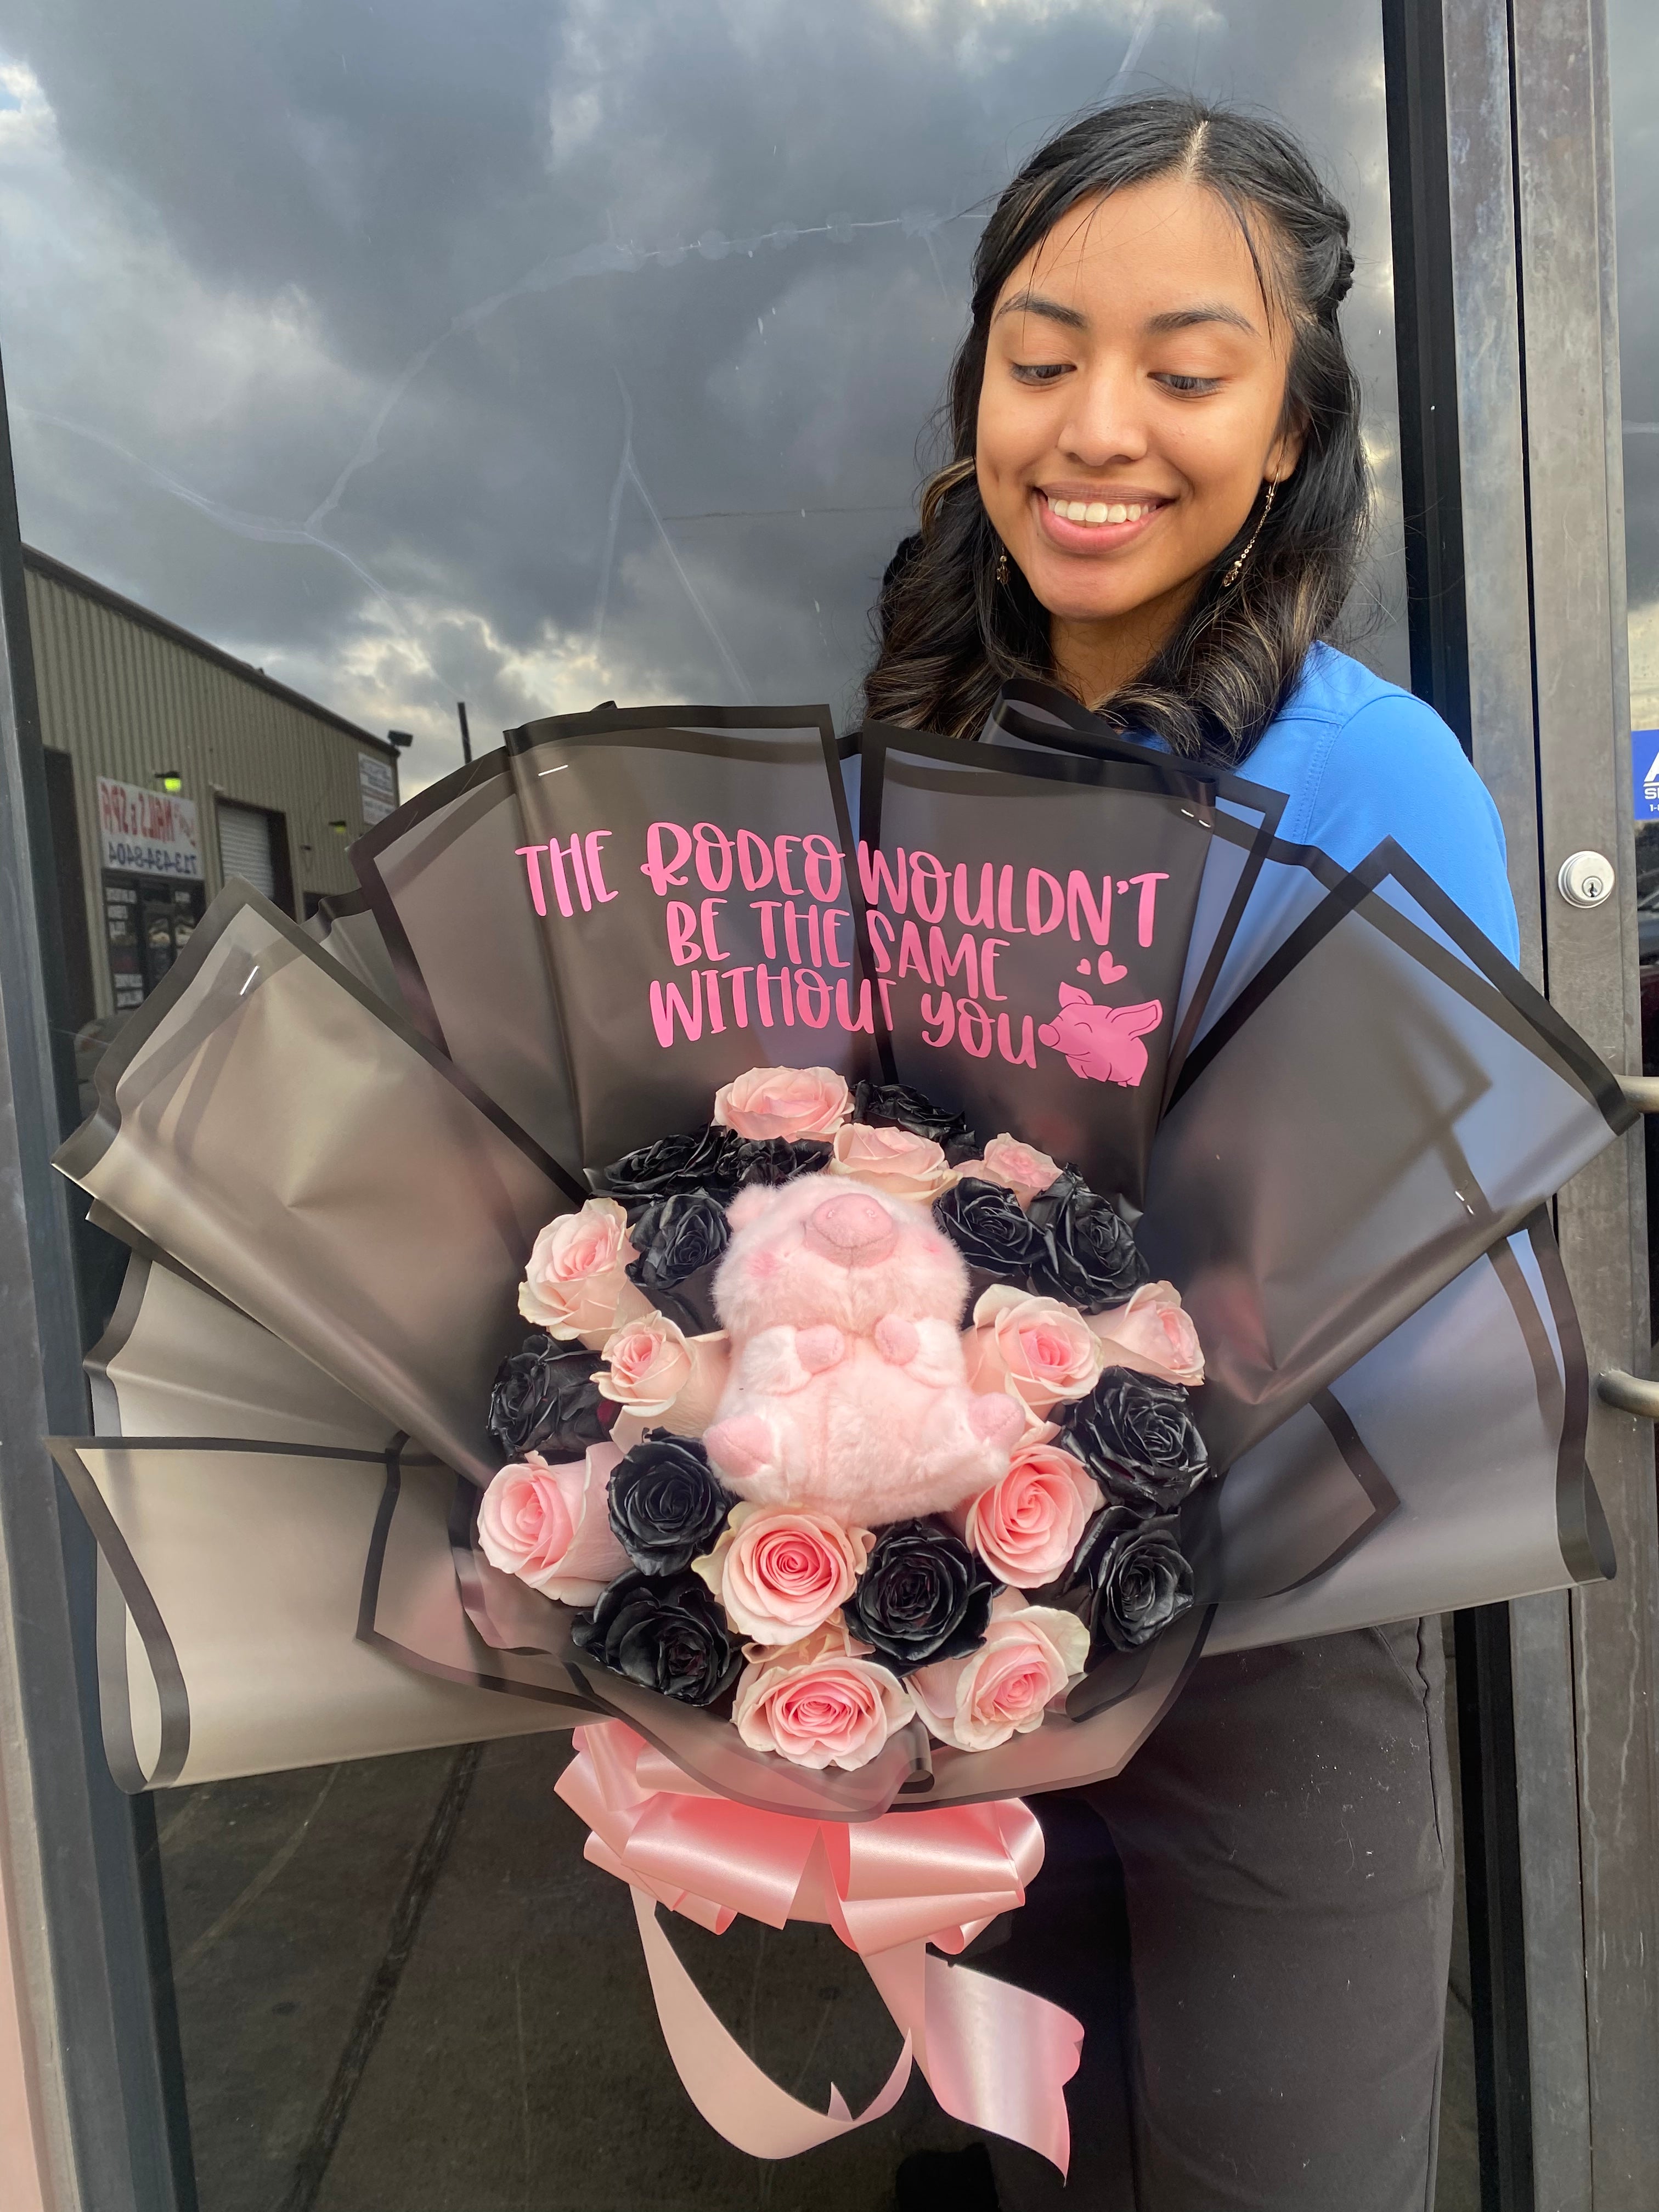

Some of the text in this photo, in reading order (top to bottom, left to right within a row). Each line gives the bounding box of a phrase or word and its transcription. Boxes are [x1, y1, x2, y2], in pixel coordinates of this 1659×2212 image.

[514, 821, 1170, 948] THE RODEO WOULDN'T
[665, 898, 1011, 1002] BE THE SAME
[648, 963, 897, 1048] WITHOUT
